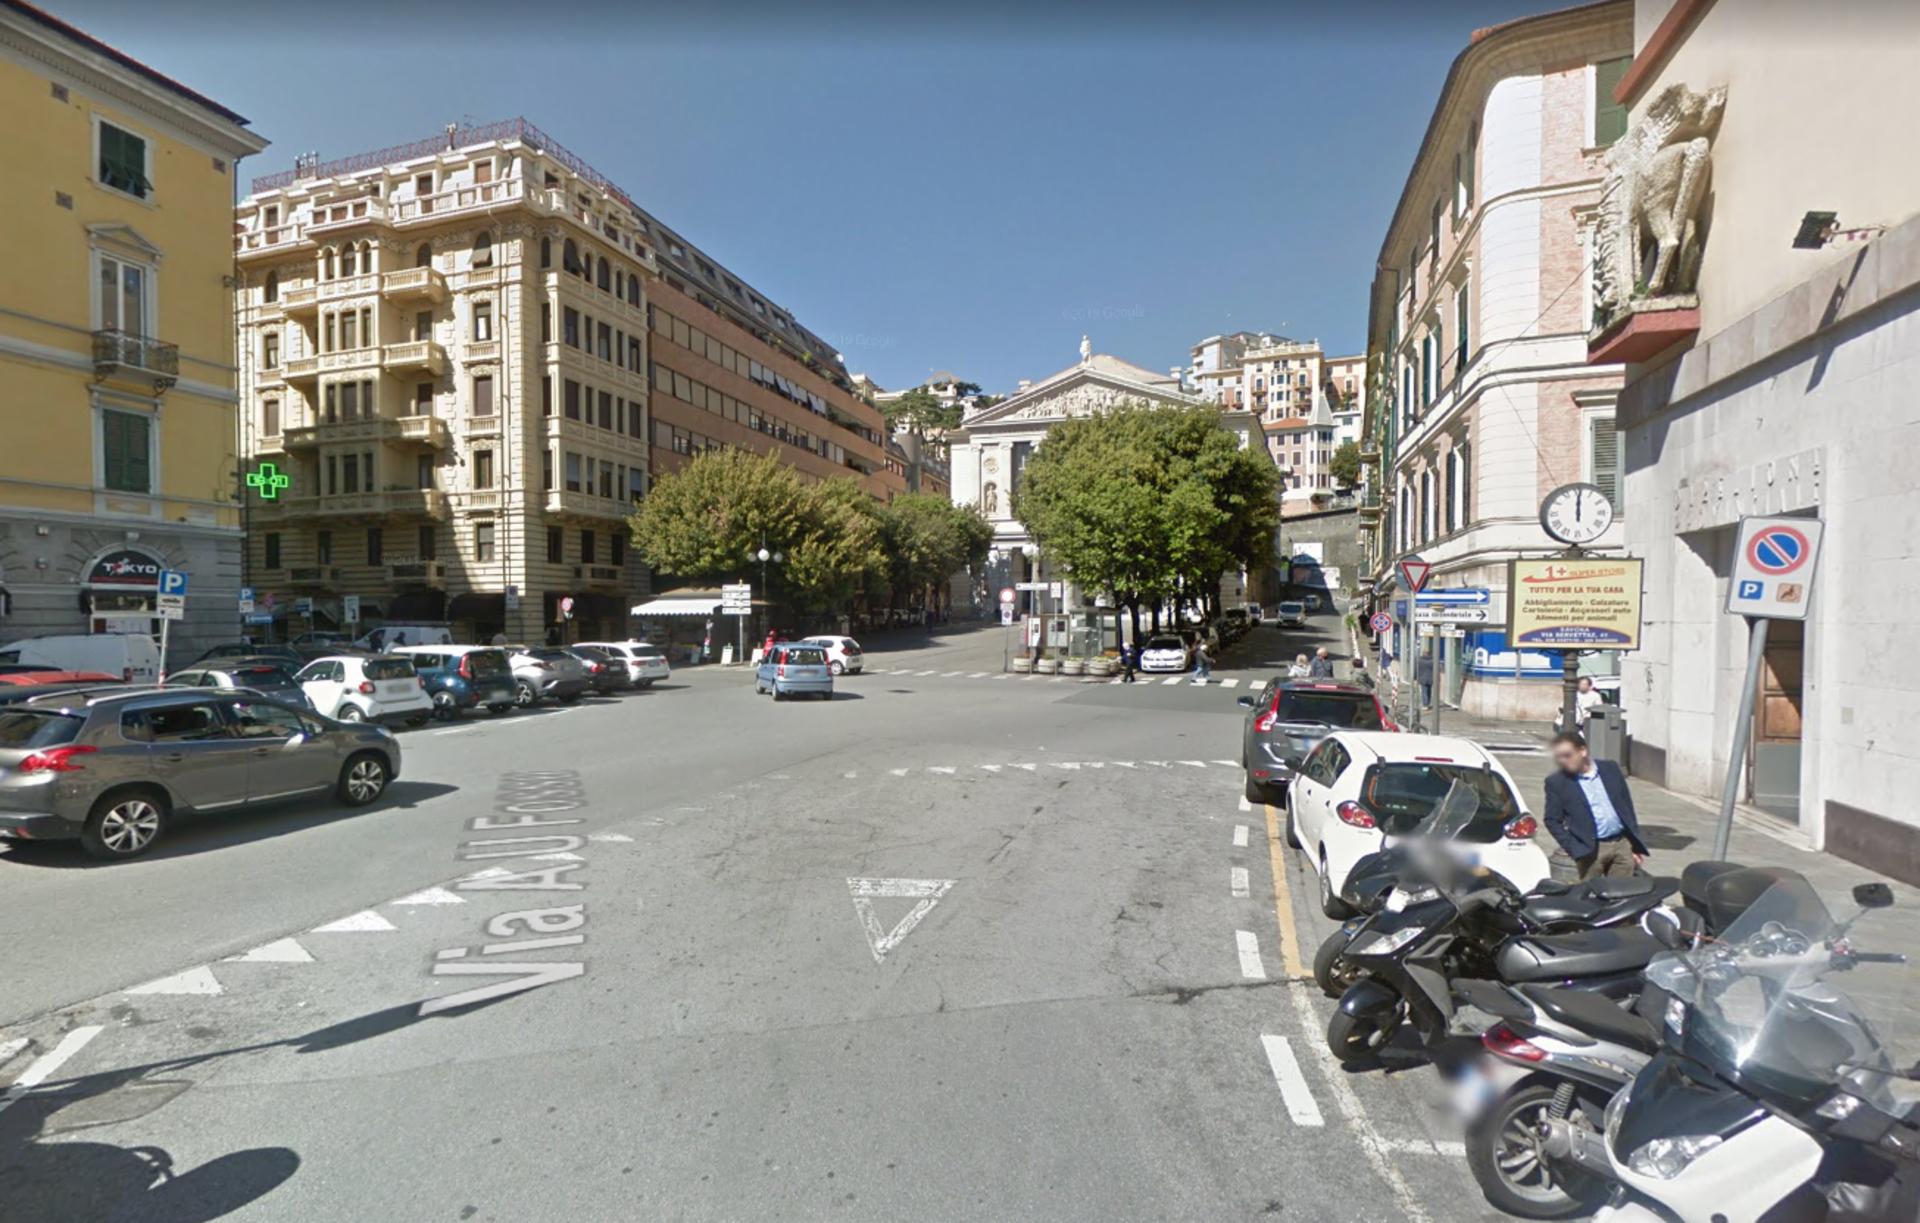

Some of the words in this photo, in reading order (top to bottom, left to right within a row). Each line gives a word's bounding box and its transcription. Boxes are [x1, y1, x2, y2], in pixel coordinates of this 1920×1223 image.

[102, 561, 158, 575] TOKYO
[165, 573, 183, 592] P
[1529, 586, 1555, 594] TUTTO
[1557, 586, 1572, 594] PER
[1574, 586, 1584, 594] LA
[1586, 586, 1601, 594] TUA
[1603, 586, 1624, 594] CASA
[1743, 583, 1758, 597] P
